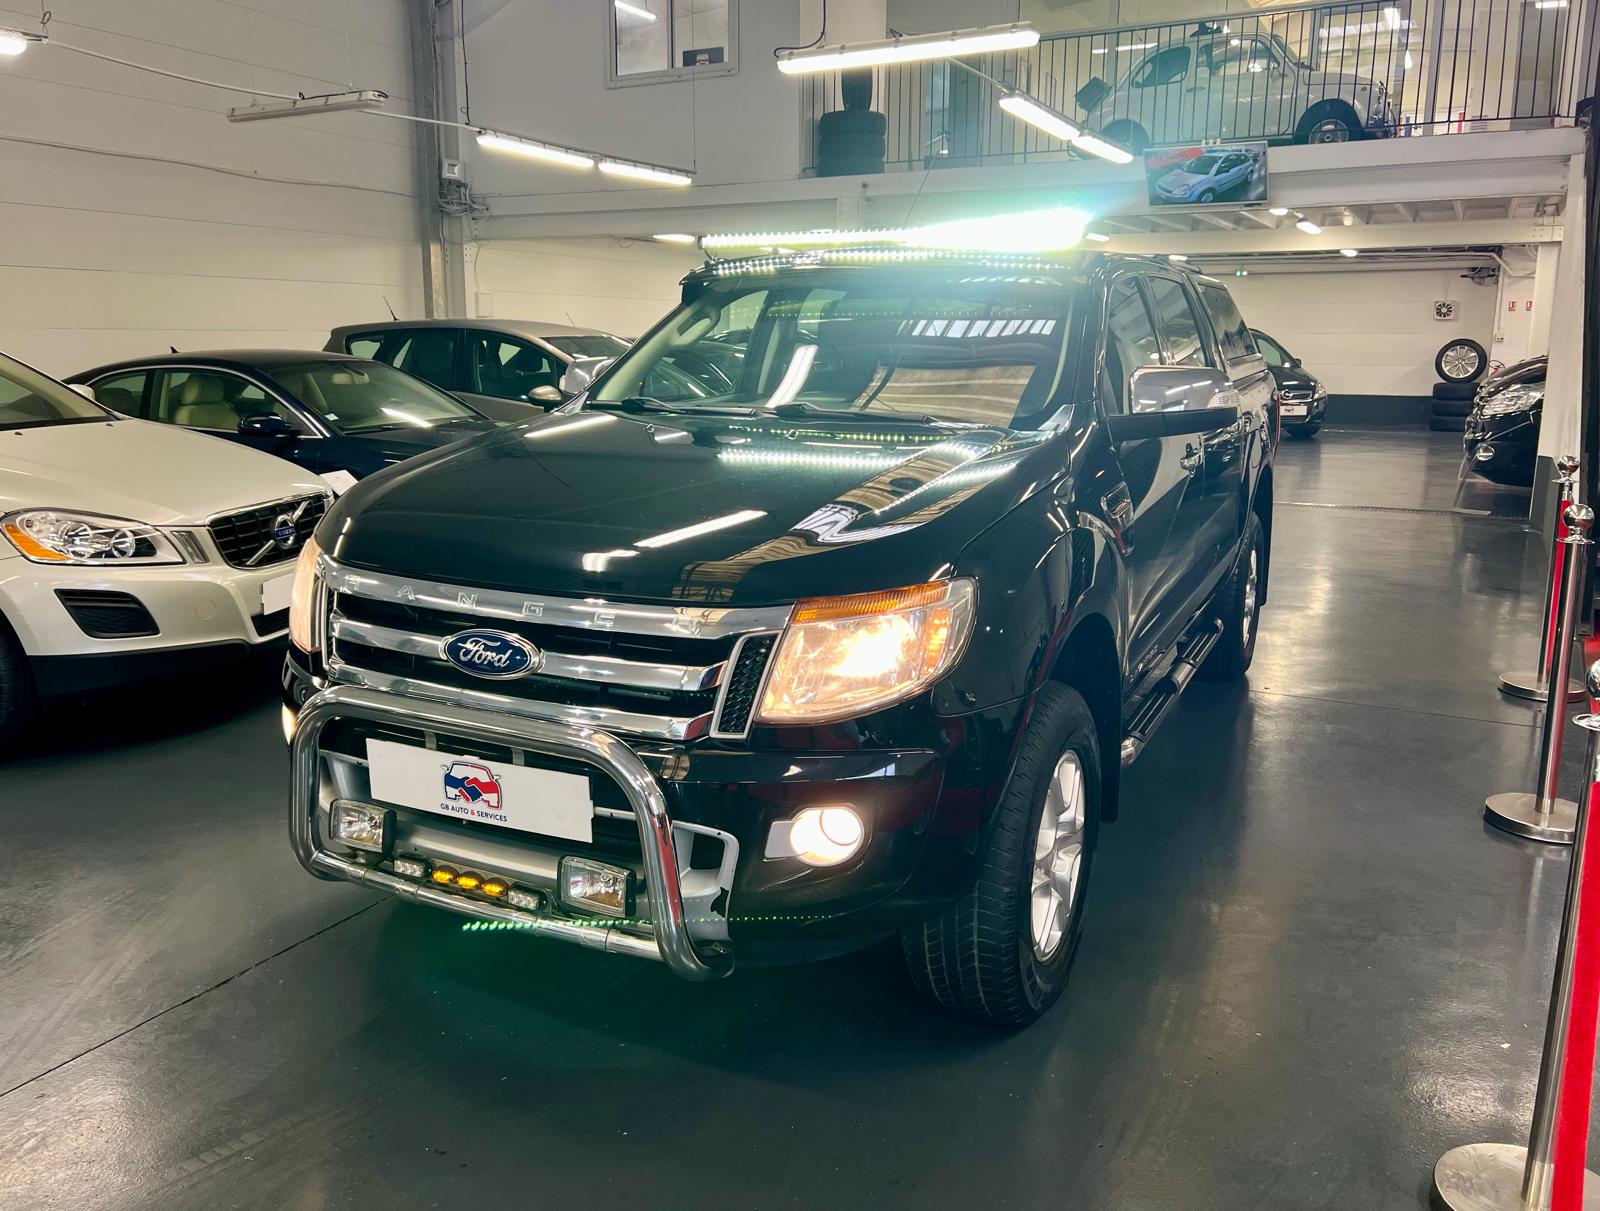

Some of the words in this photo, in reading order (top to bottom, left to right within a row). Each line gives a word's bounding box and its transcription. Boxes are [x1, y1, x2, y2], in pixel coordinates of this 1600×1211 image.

[343, 573, 702, 638] RANGER
[457, 637, 513, 668] Ford
[440, 803, 450, 811] GB
[450, 806, 468, 815] AUTO
[476, 811, 507, 822] SERVICES
